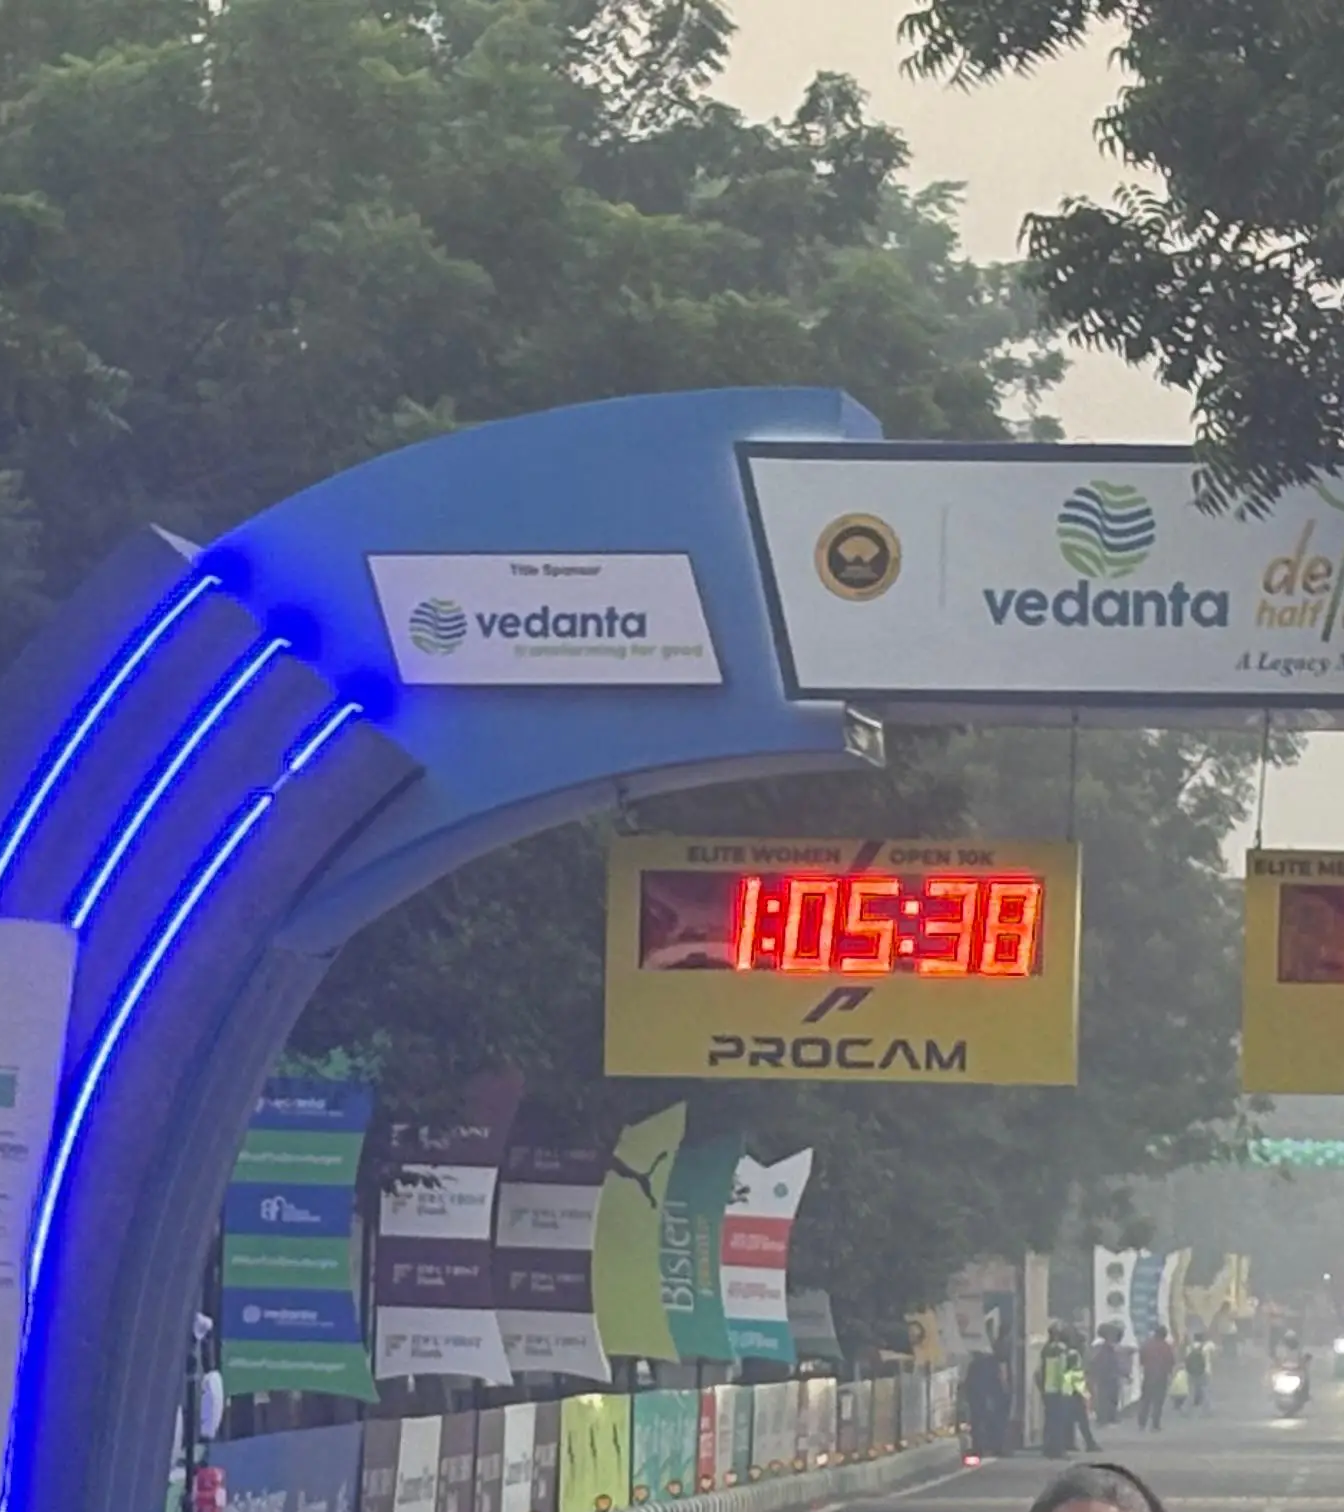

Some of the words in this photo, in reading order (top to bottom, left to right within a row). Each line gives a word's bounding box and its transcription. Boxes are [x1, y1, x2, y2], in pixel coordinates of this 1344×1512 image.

[510, 563, 540, 577] Title
[542, 564, 602, 579] Sponsor
[982, 579, 1230, 629] vedanta
[1256, 598, 1325, 630] half
[475, 605, 648, 639] vedanta
[1234, 652, 1252, 672] A
[1256, 651, 1331, 678] Legacy
[686, 845, 745, 864] ELITE
[751, 845, 842, 865] WOMEN
[889, 848, 953, 867] OPEN
[1253, 859, 1314, 876] ELITE
[734, 874, 1044, 977] 1:05:38
[706, 1033, 968, 1073] PROCAM
